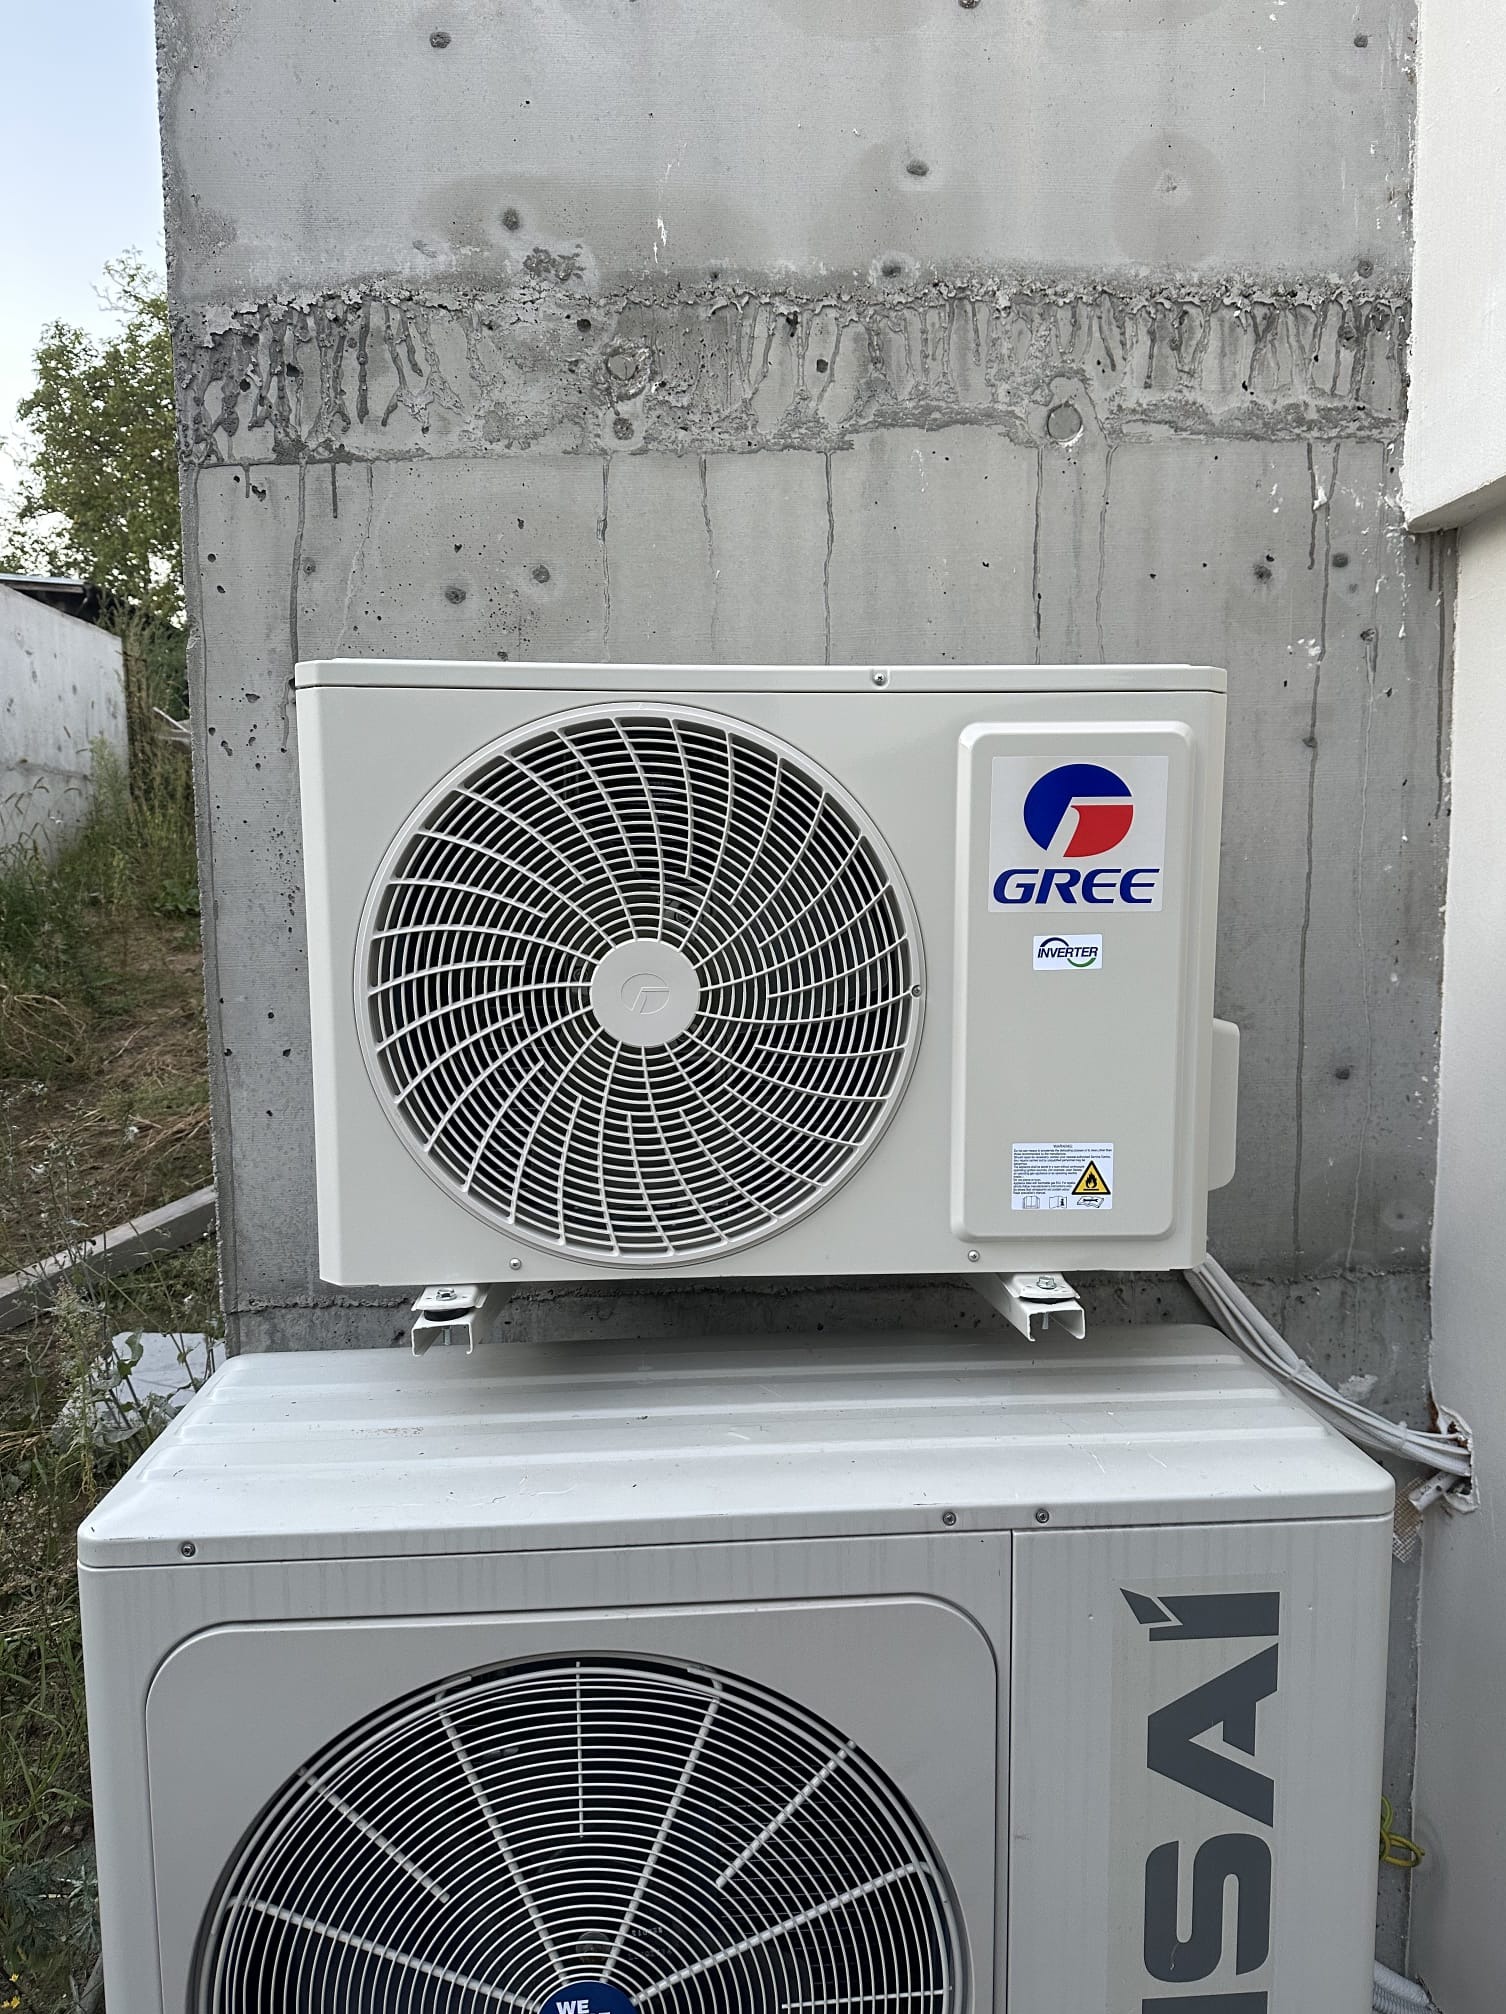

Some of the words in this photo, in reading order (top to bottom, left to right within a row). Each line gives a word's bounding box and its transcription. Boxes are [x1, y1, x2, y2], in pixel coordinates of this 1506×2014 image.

[993, 868, 1160, 904] GREE
[1037, 946, 1098, 959] INVERTER
[556, 1999, 590, 2014] WE
